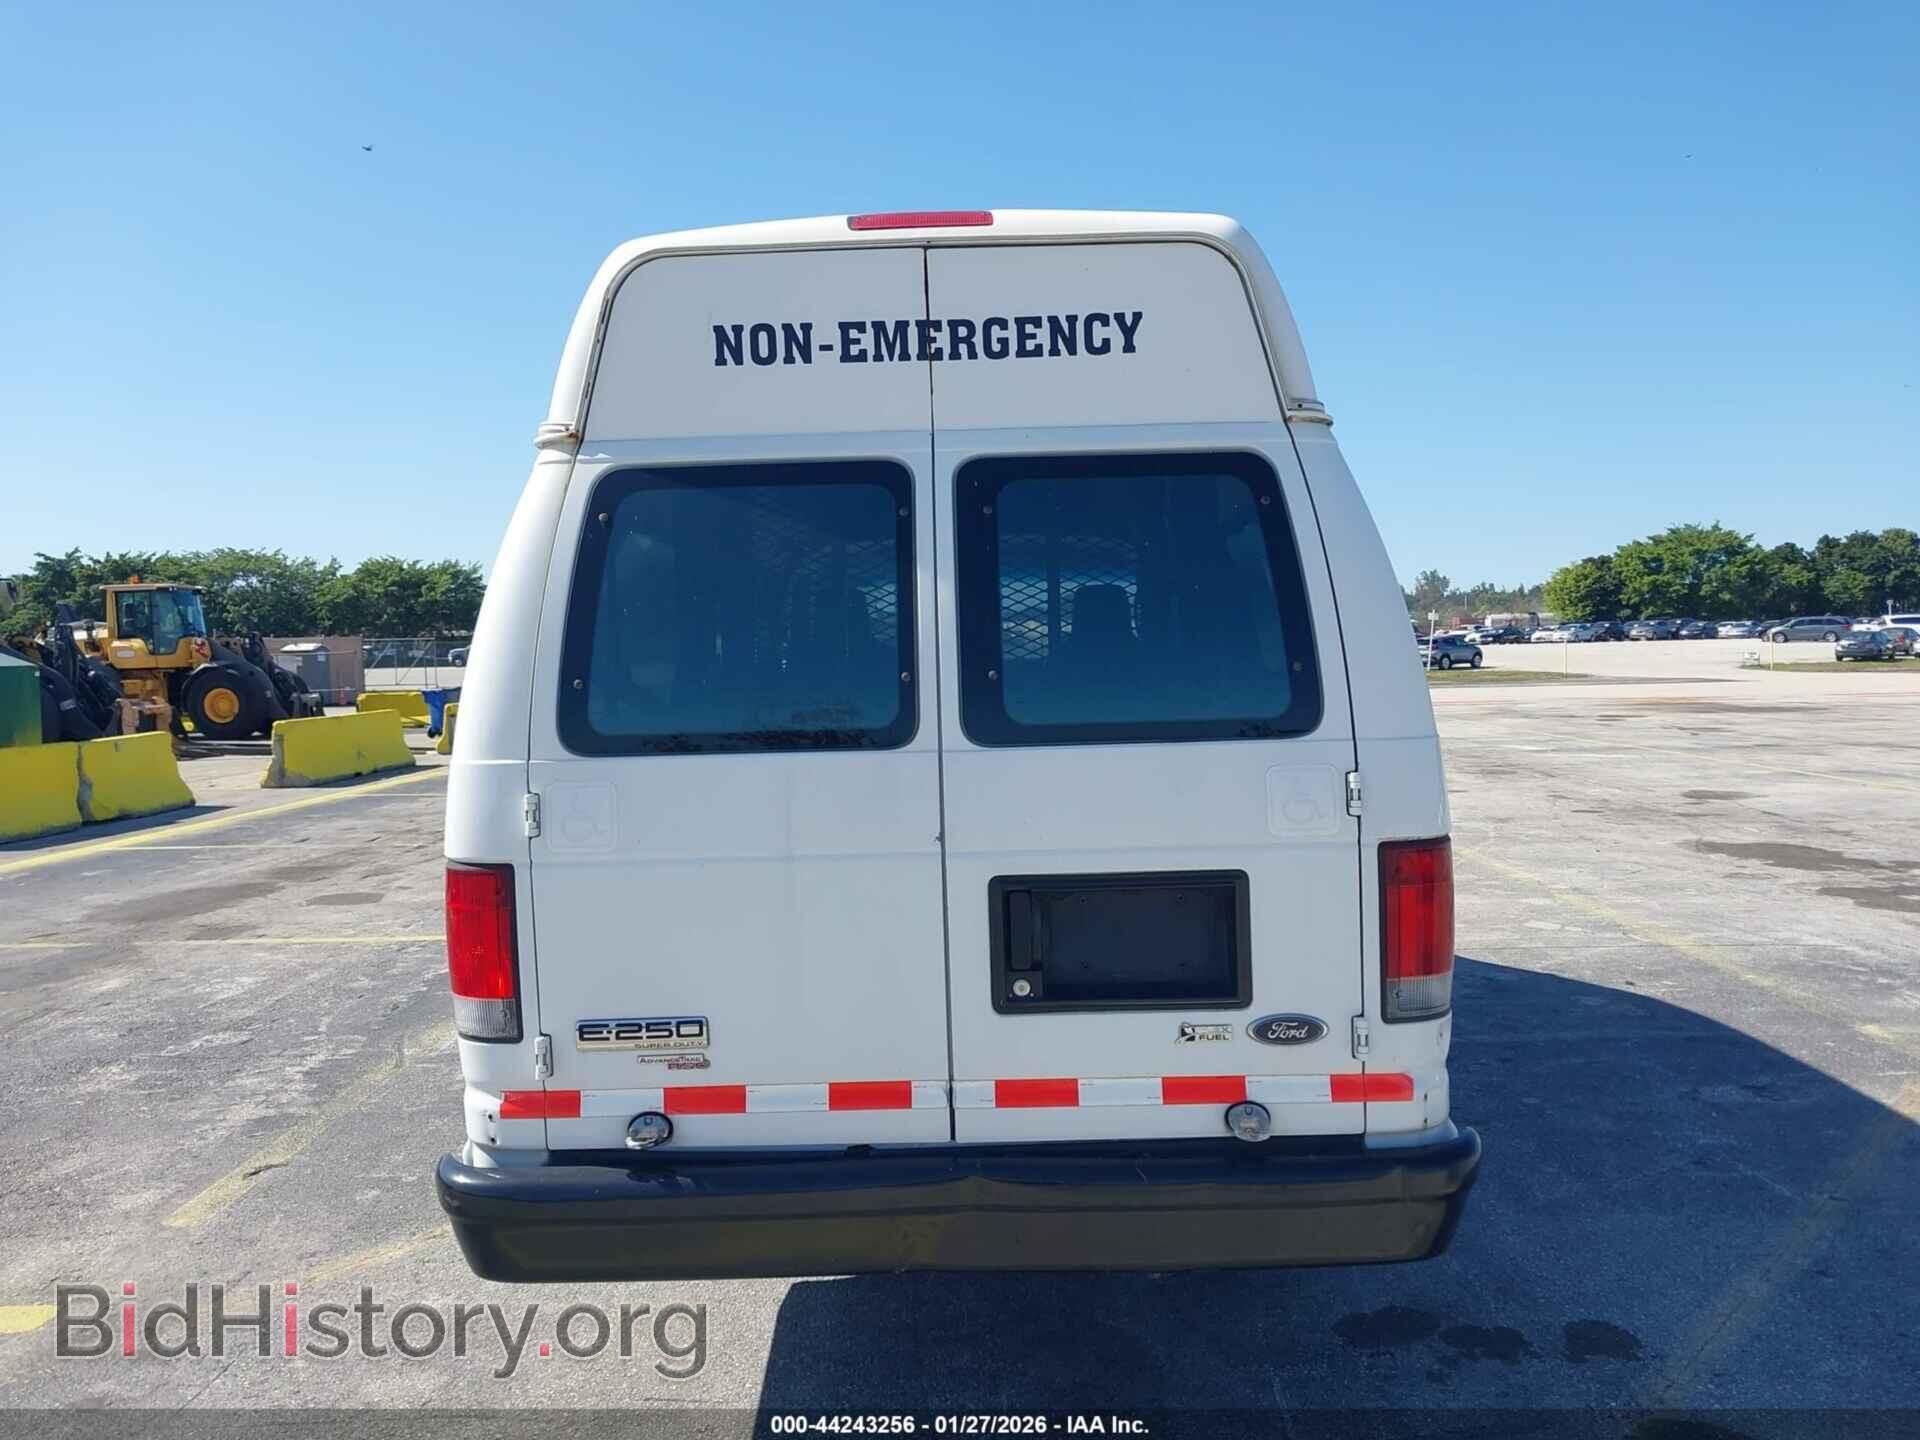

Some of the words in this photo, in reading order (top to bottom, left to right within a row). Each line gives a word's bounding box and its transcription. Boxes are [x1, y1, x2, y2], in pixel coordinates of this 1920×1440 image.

[712, 311, 1144, 367] NON-EMERGENCY
[1199, 1033, 1230, 1041] FUEL
[1267, 1021, 1309, 1039] Ford
